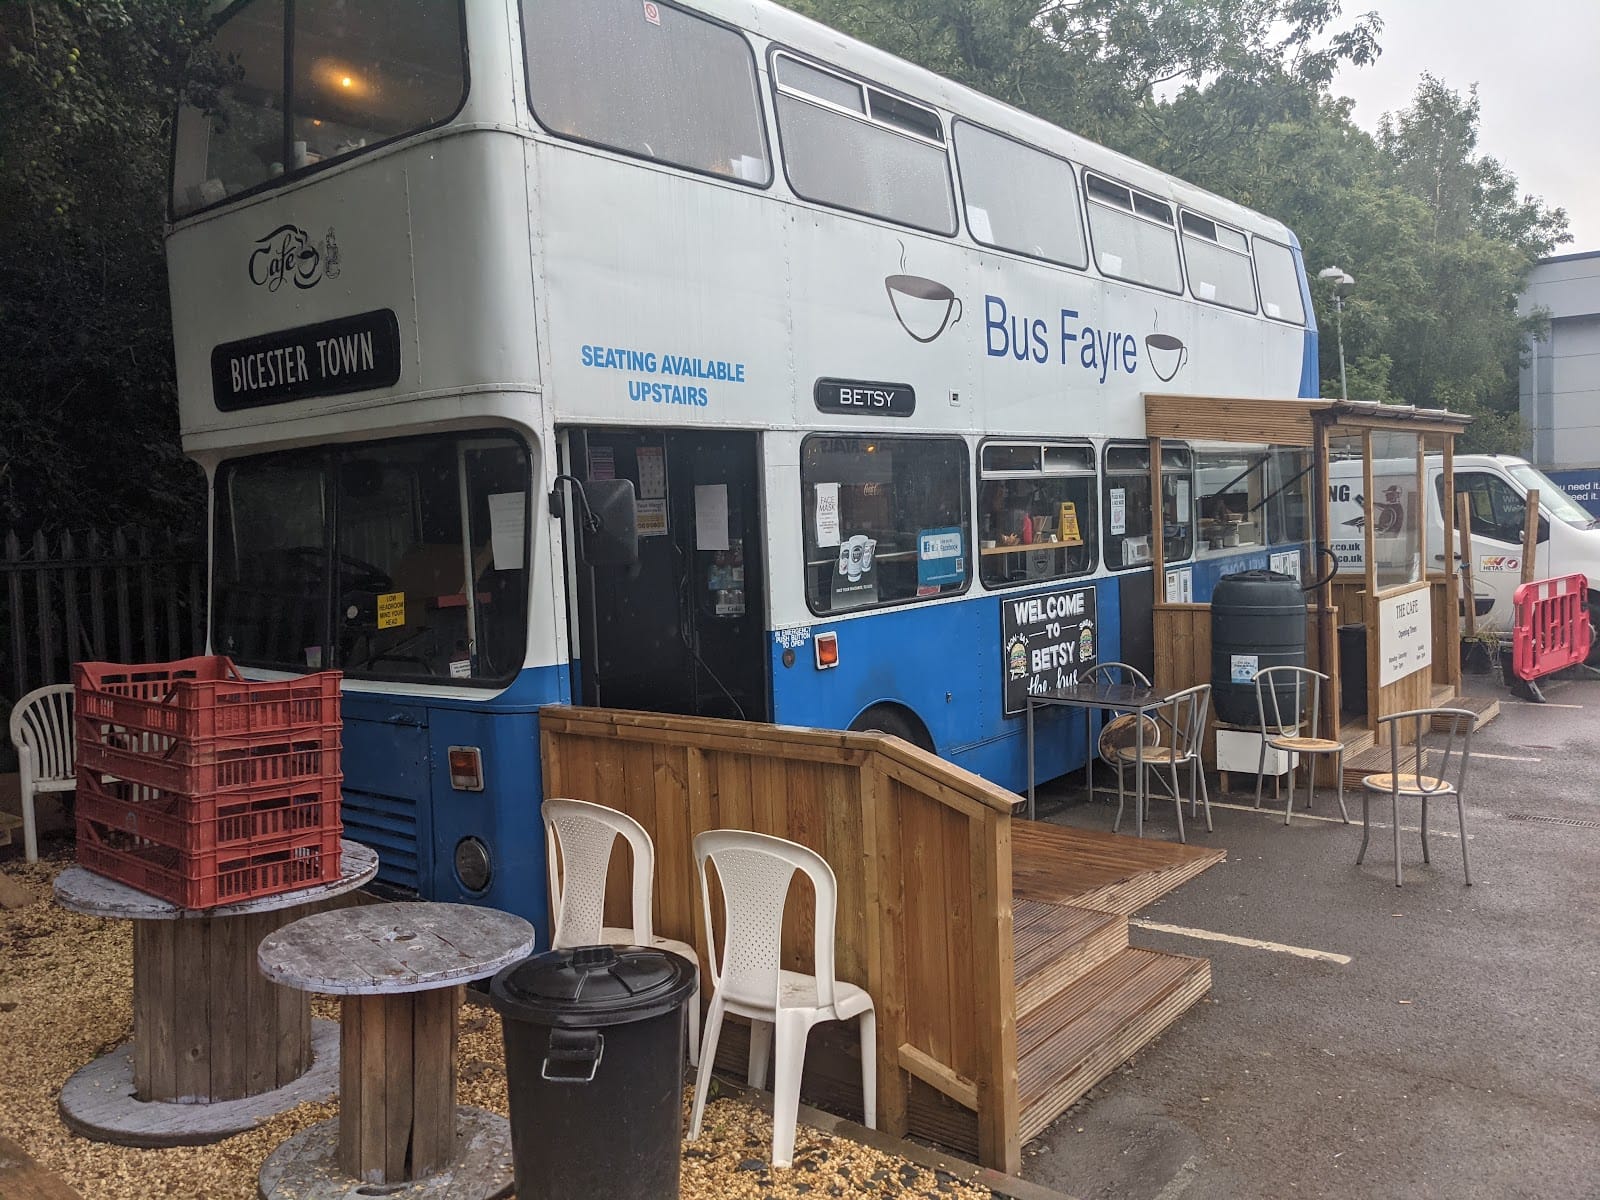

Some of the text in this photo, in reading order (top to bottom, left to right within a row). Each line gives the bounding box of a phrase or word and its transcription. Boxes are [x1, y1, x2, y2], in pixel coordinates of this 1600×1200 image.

[985, 294, 1137, 385] Bus Fayre
[231, 331, 375, 392] BICESTER TOWN
[581, 344, 745, 383] SEATING AVAILABLE
[628, 380, 708, 407] UPSTAIRS
[839, 388, 895, 407] BETSY
[1328, 484, 1350, 503] NG
[1567, 482, 1591, 491] need
[820, 496, 836, 504] FACE
[1571, 492, 1589, 501] eed
[819, 503, 836, 512] MASK
[1330, 542, 1361, 551] r.co.uk
[1338, 554, 1363, 563] co.uk
[1014, 592, 1085, 625] WELCOME
[1396, 600, 1418, 619] THE CAFE
[776, 635, 789, 643] PUSH
[782, 627, 811, 635] EMERGENCY
[1046, 622, 1061, 639] TO
[791, 639, 804, 648] OPEN
[1031, 641, 1076, 673] BETSY
